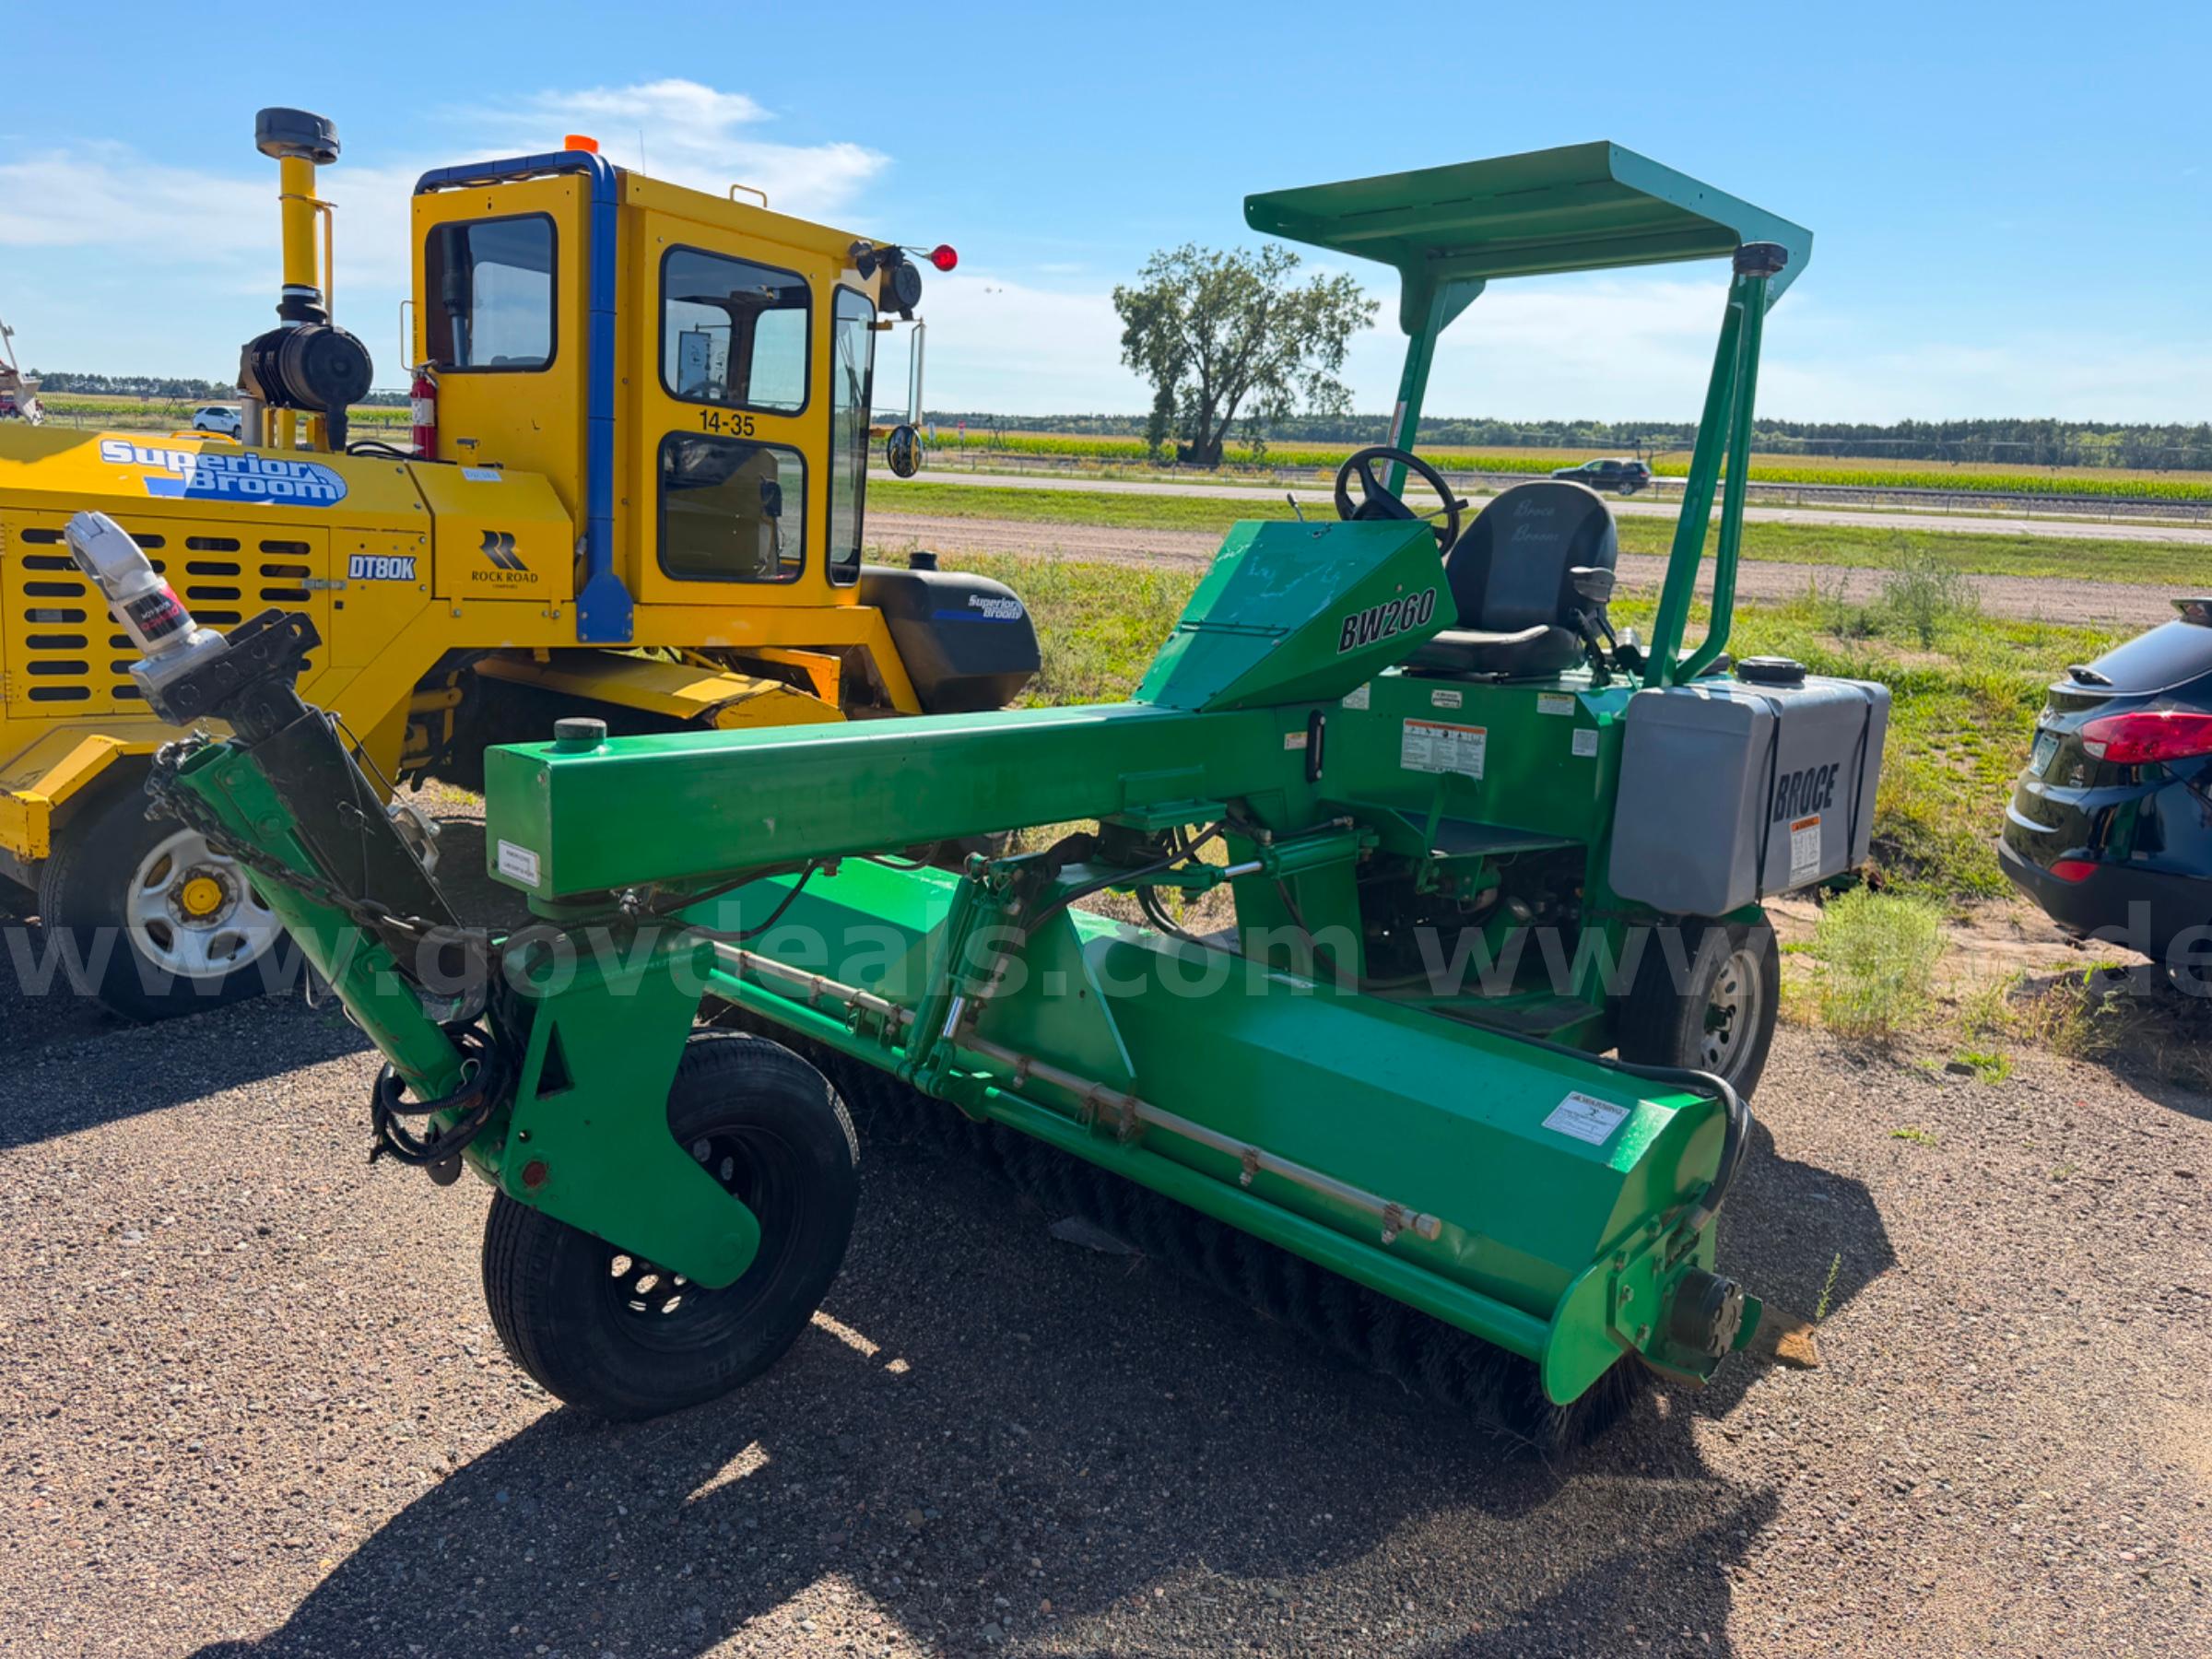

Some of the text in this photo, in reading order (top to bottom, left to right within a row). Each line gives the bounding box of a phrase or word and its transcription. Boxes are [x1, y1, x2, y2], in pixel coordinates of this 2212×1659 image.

[700, 409, 754, 436] 14-35
[100, 440, 311, 478] Superior
[190, 469, 338, 500] Broom
[348, 555, 416, 580] DT80K
[472, 571, 538, 582] ROCK ROAD
[968, 594, 1017, 610] Superior
[982, 607, 1018, 619] Broom
[1336, 587, 1436, 654] BW260
[1772, 762, 1840, 823] BROCE
